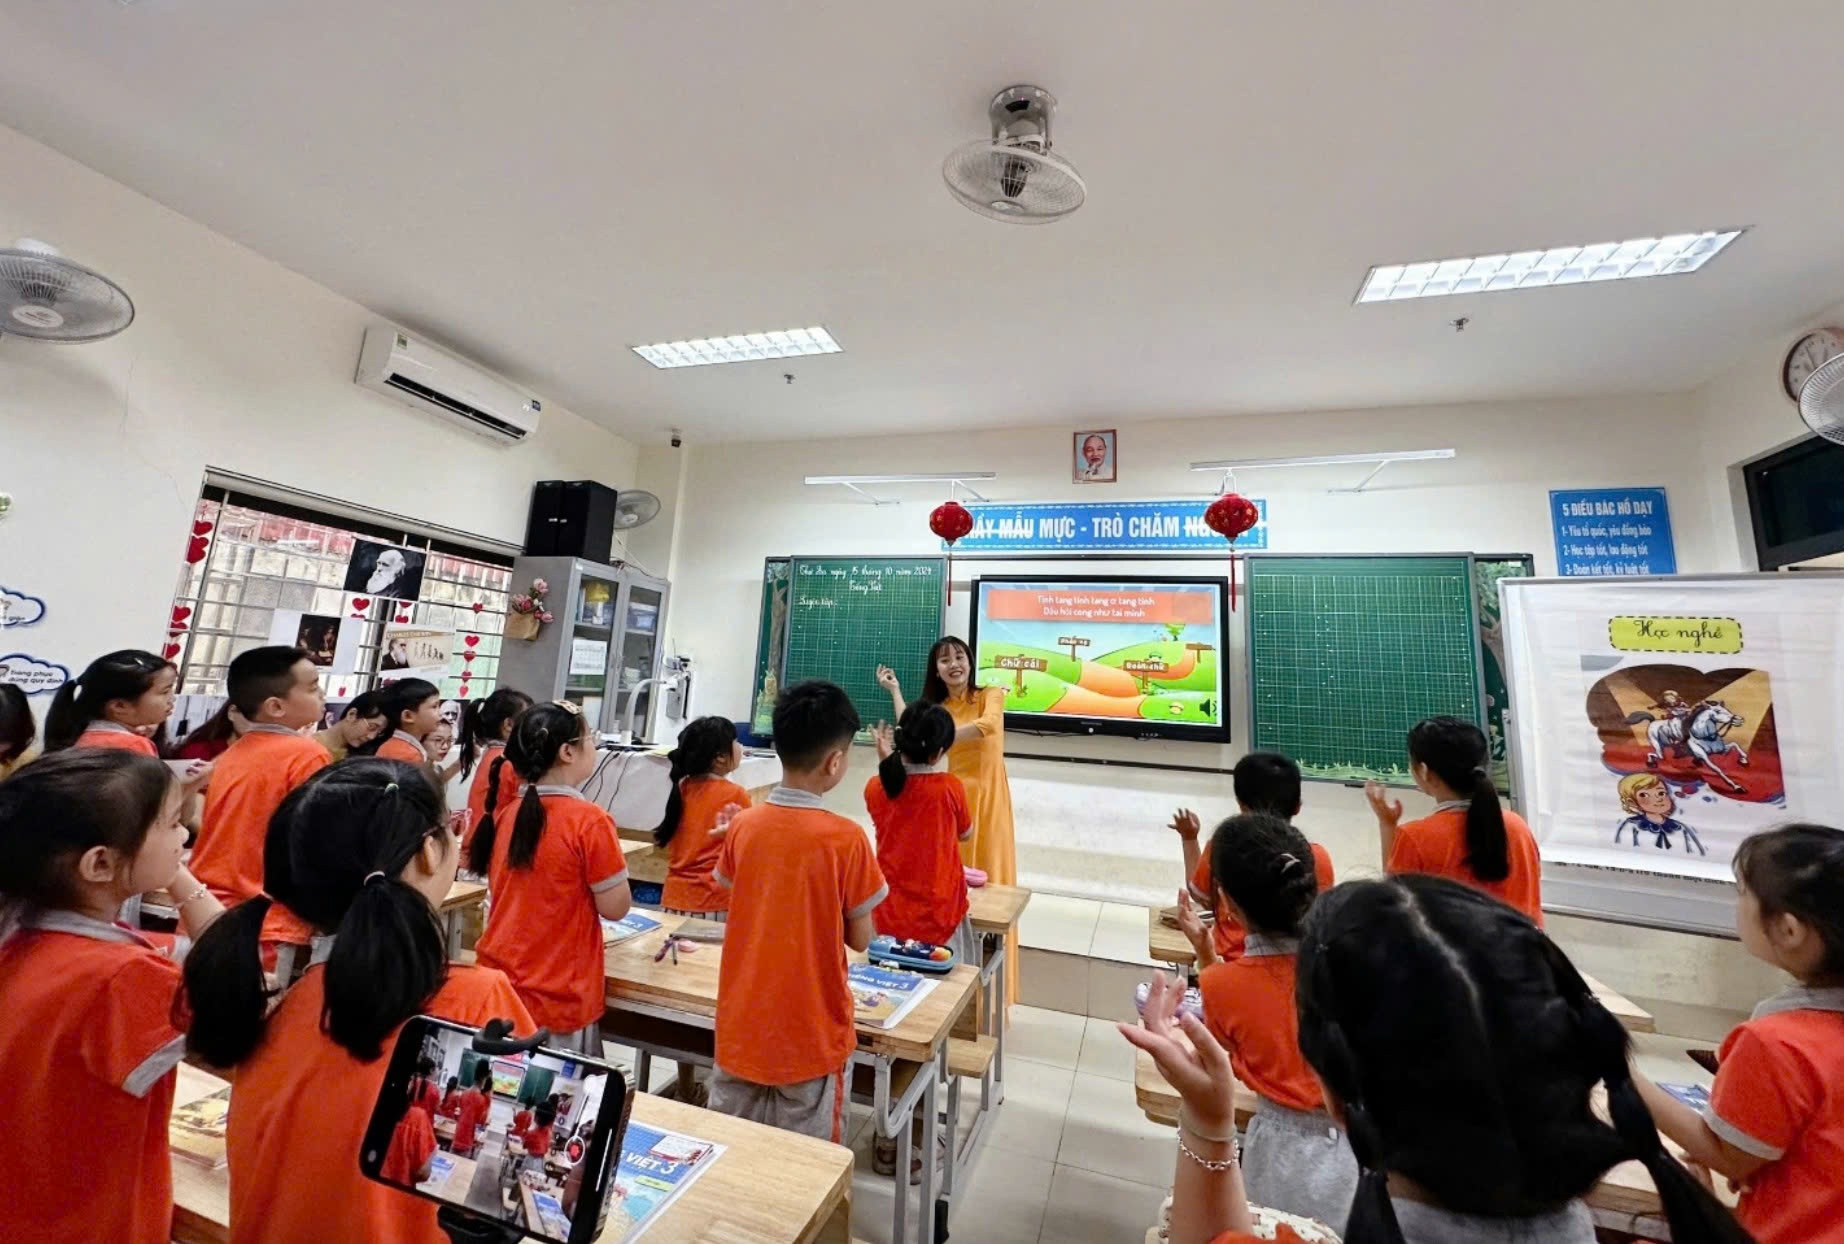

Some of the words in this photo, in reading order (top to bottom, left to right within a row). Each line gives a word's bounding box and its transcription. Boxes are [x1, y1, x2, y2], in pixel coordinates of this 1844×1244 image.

[1562, 503, 1569, 516] 5
[1595, 499, 1615, 516] BÁC
[1633, 501, 1653, 518] DẠY
[999, 511, 1034, 539] MẪU
[1039, 516, 1076, 543] MỰC
[1092, 512, 1122, 538] TRÒ
[1129, 511, 1179, 539] CHĂM
[1000, 657, 1020, 668] Chữ
[1023, 658, 1040, 669] cái
[660, 1161, 680, 1175] 3
